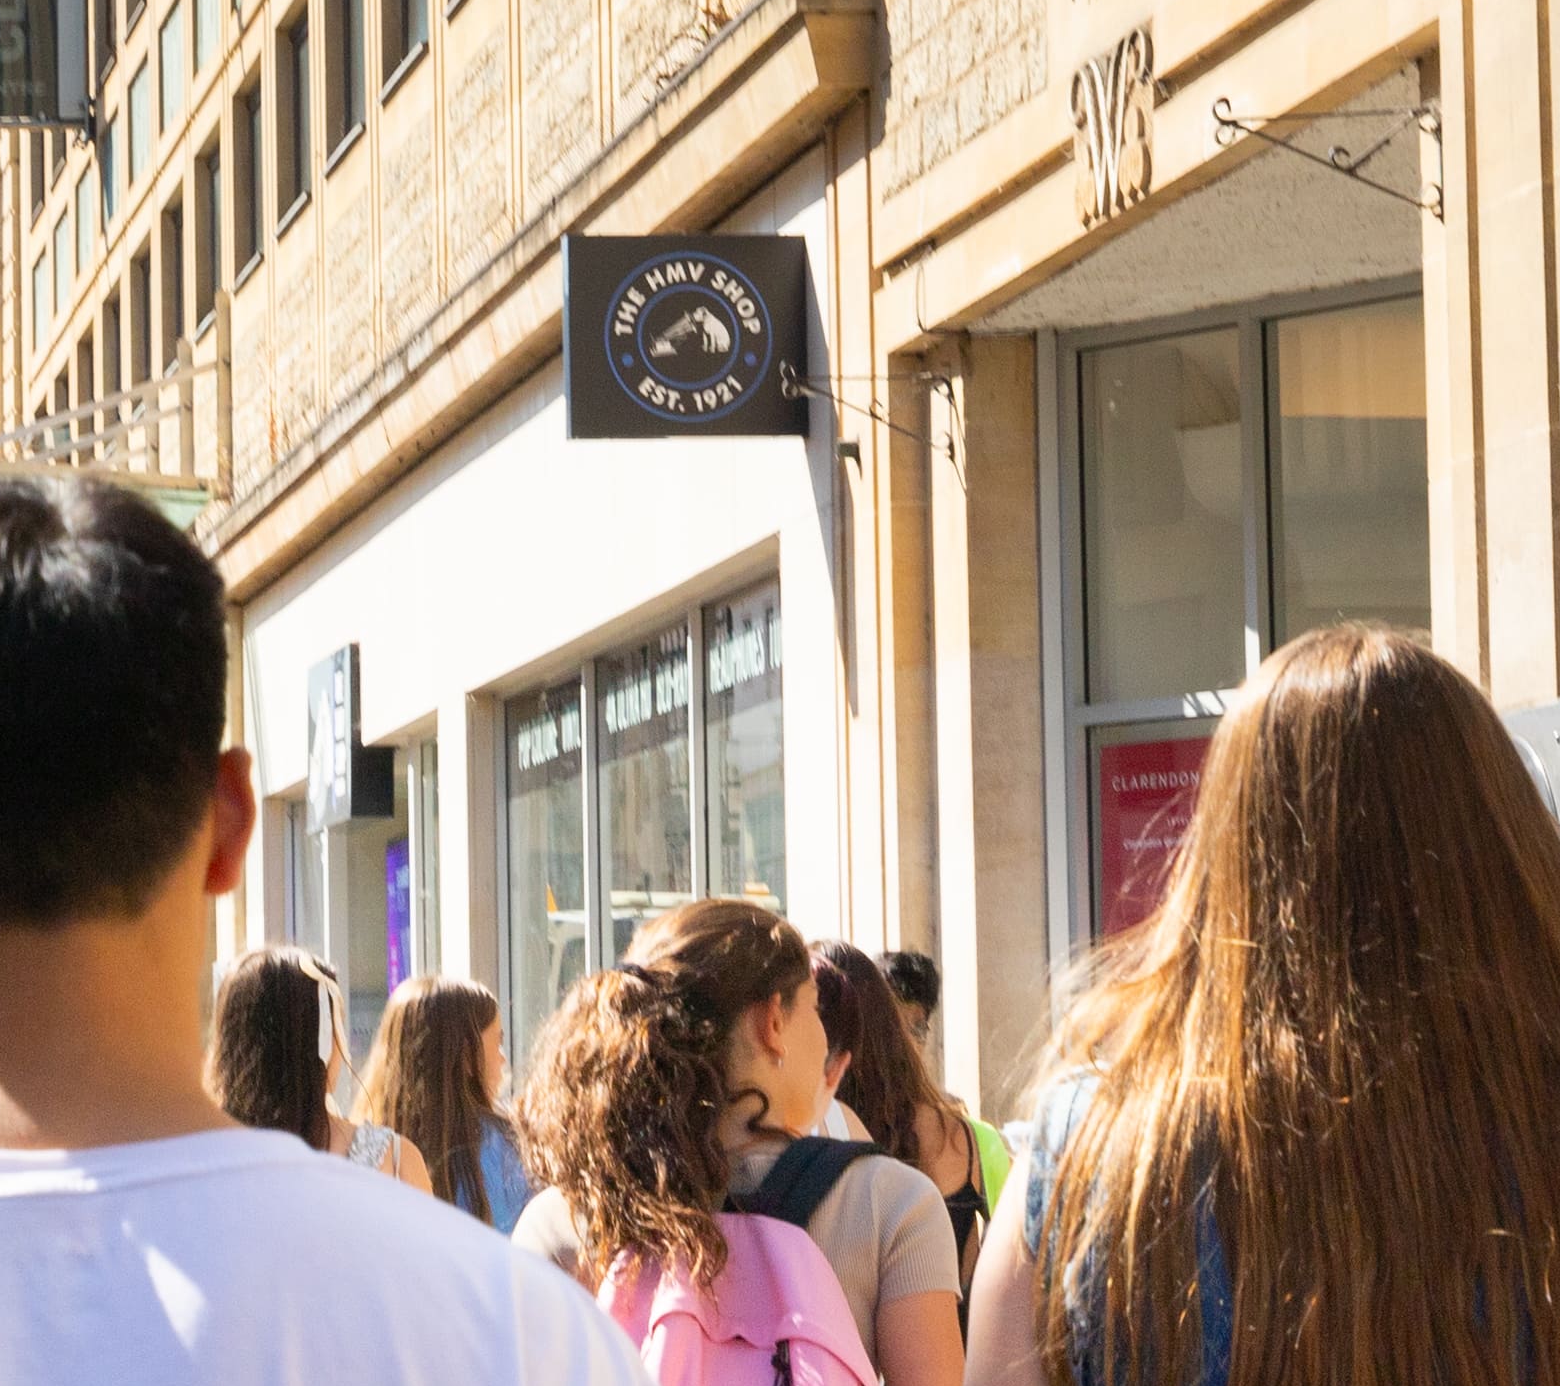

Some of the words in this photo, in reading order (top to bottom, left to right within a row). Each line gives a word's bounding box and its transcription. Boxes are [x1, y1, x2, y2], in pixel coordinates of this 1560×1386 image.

[614, 287, 646, 337] THE
[644, 261, 706, 293] HMV
[710, 269, 762, 335] SHOP
[637, 375, 686, 413] EST.
[692, 373, 744, 413] 1921
[1111, 770, 1201, 793] CLARENDON
